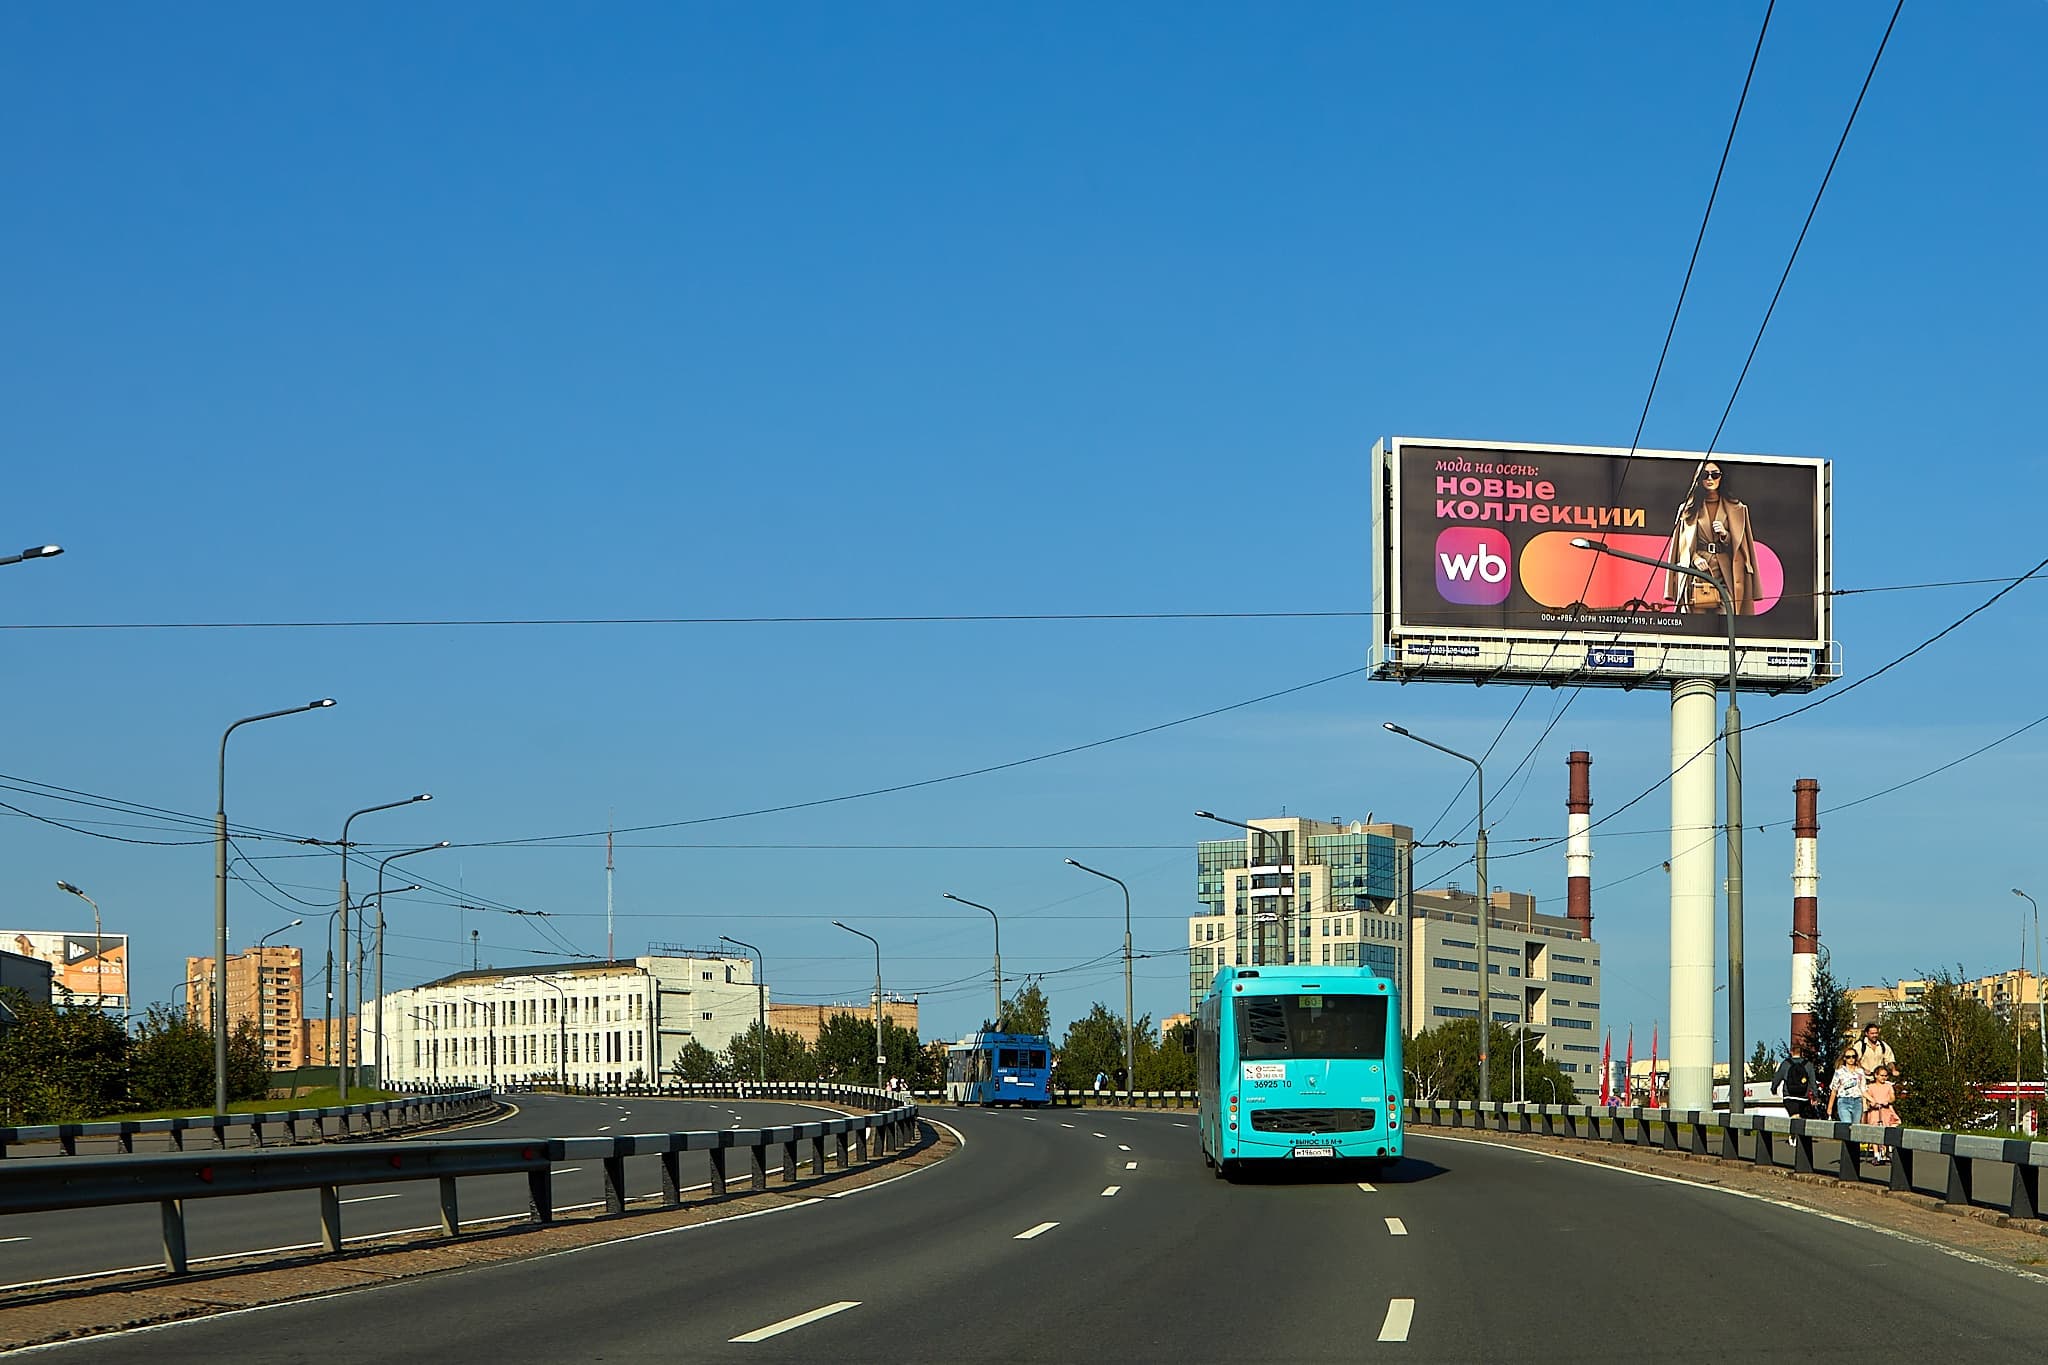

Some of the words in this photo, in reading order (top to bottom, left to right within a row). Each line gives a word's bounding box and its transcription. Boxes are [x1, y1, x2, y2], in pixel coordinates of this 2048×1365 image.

[1435, 459, 1472, 474] мода
[1475, 463, 1493, 475] на
[1496, 464, 1539, 477] осень:
[1436, 476, 1555, 500] новые
[1436, 499, 1646, 529] коллекции
[1439, 543, 1507, 583] wb
[1580, 615, 1597, 623] ОГРН
